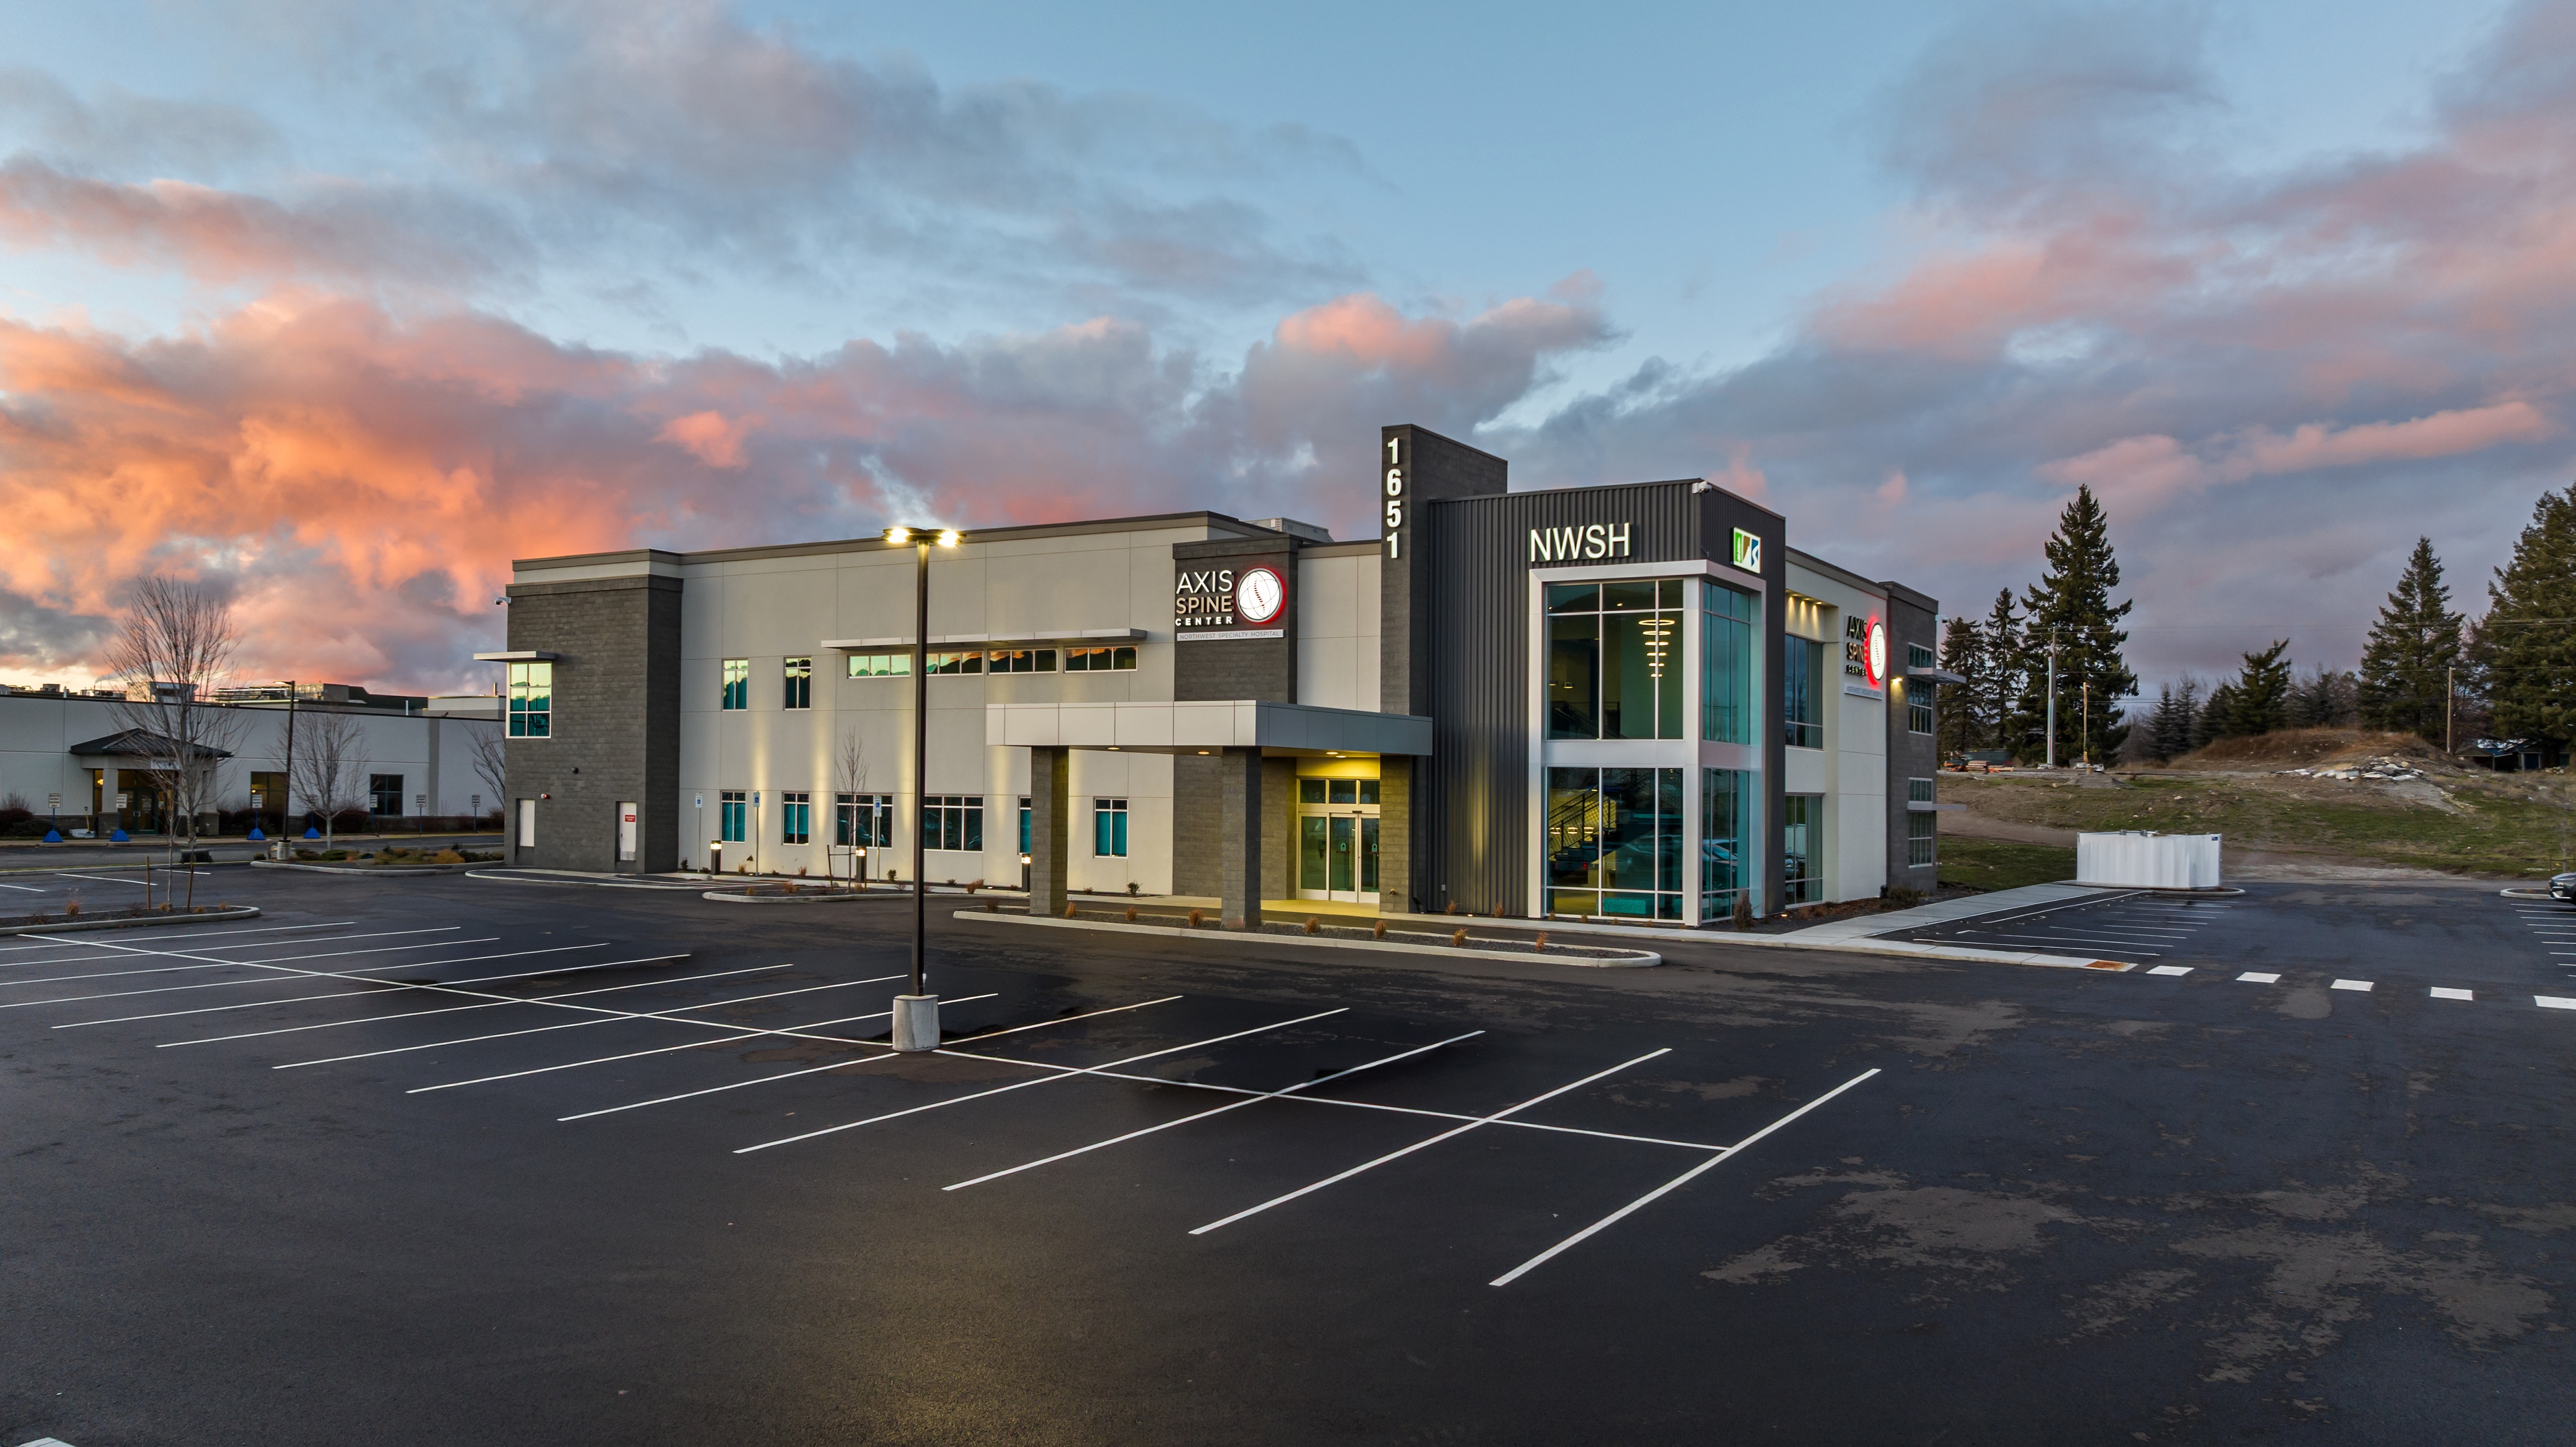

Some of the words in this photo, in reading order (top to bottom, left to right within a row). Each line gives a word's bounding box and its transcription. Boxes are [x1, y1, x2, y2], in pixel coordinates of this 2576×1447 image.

[1387, 437, 1402, 558] 1651
[1530, 522, 1630, 562] NWSH
[1176, 570, 1233, 594] AXIS
[1176, 596, 1232, 614] SPINE
[1175, 616, 1232, 626] CENTER
[1846, 616, 1867, 641] AXIS
